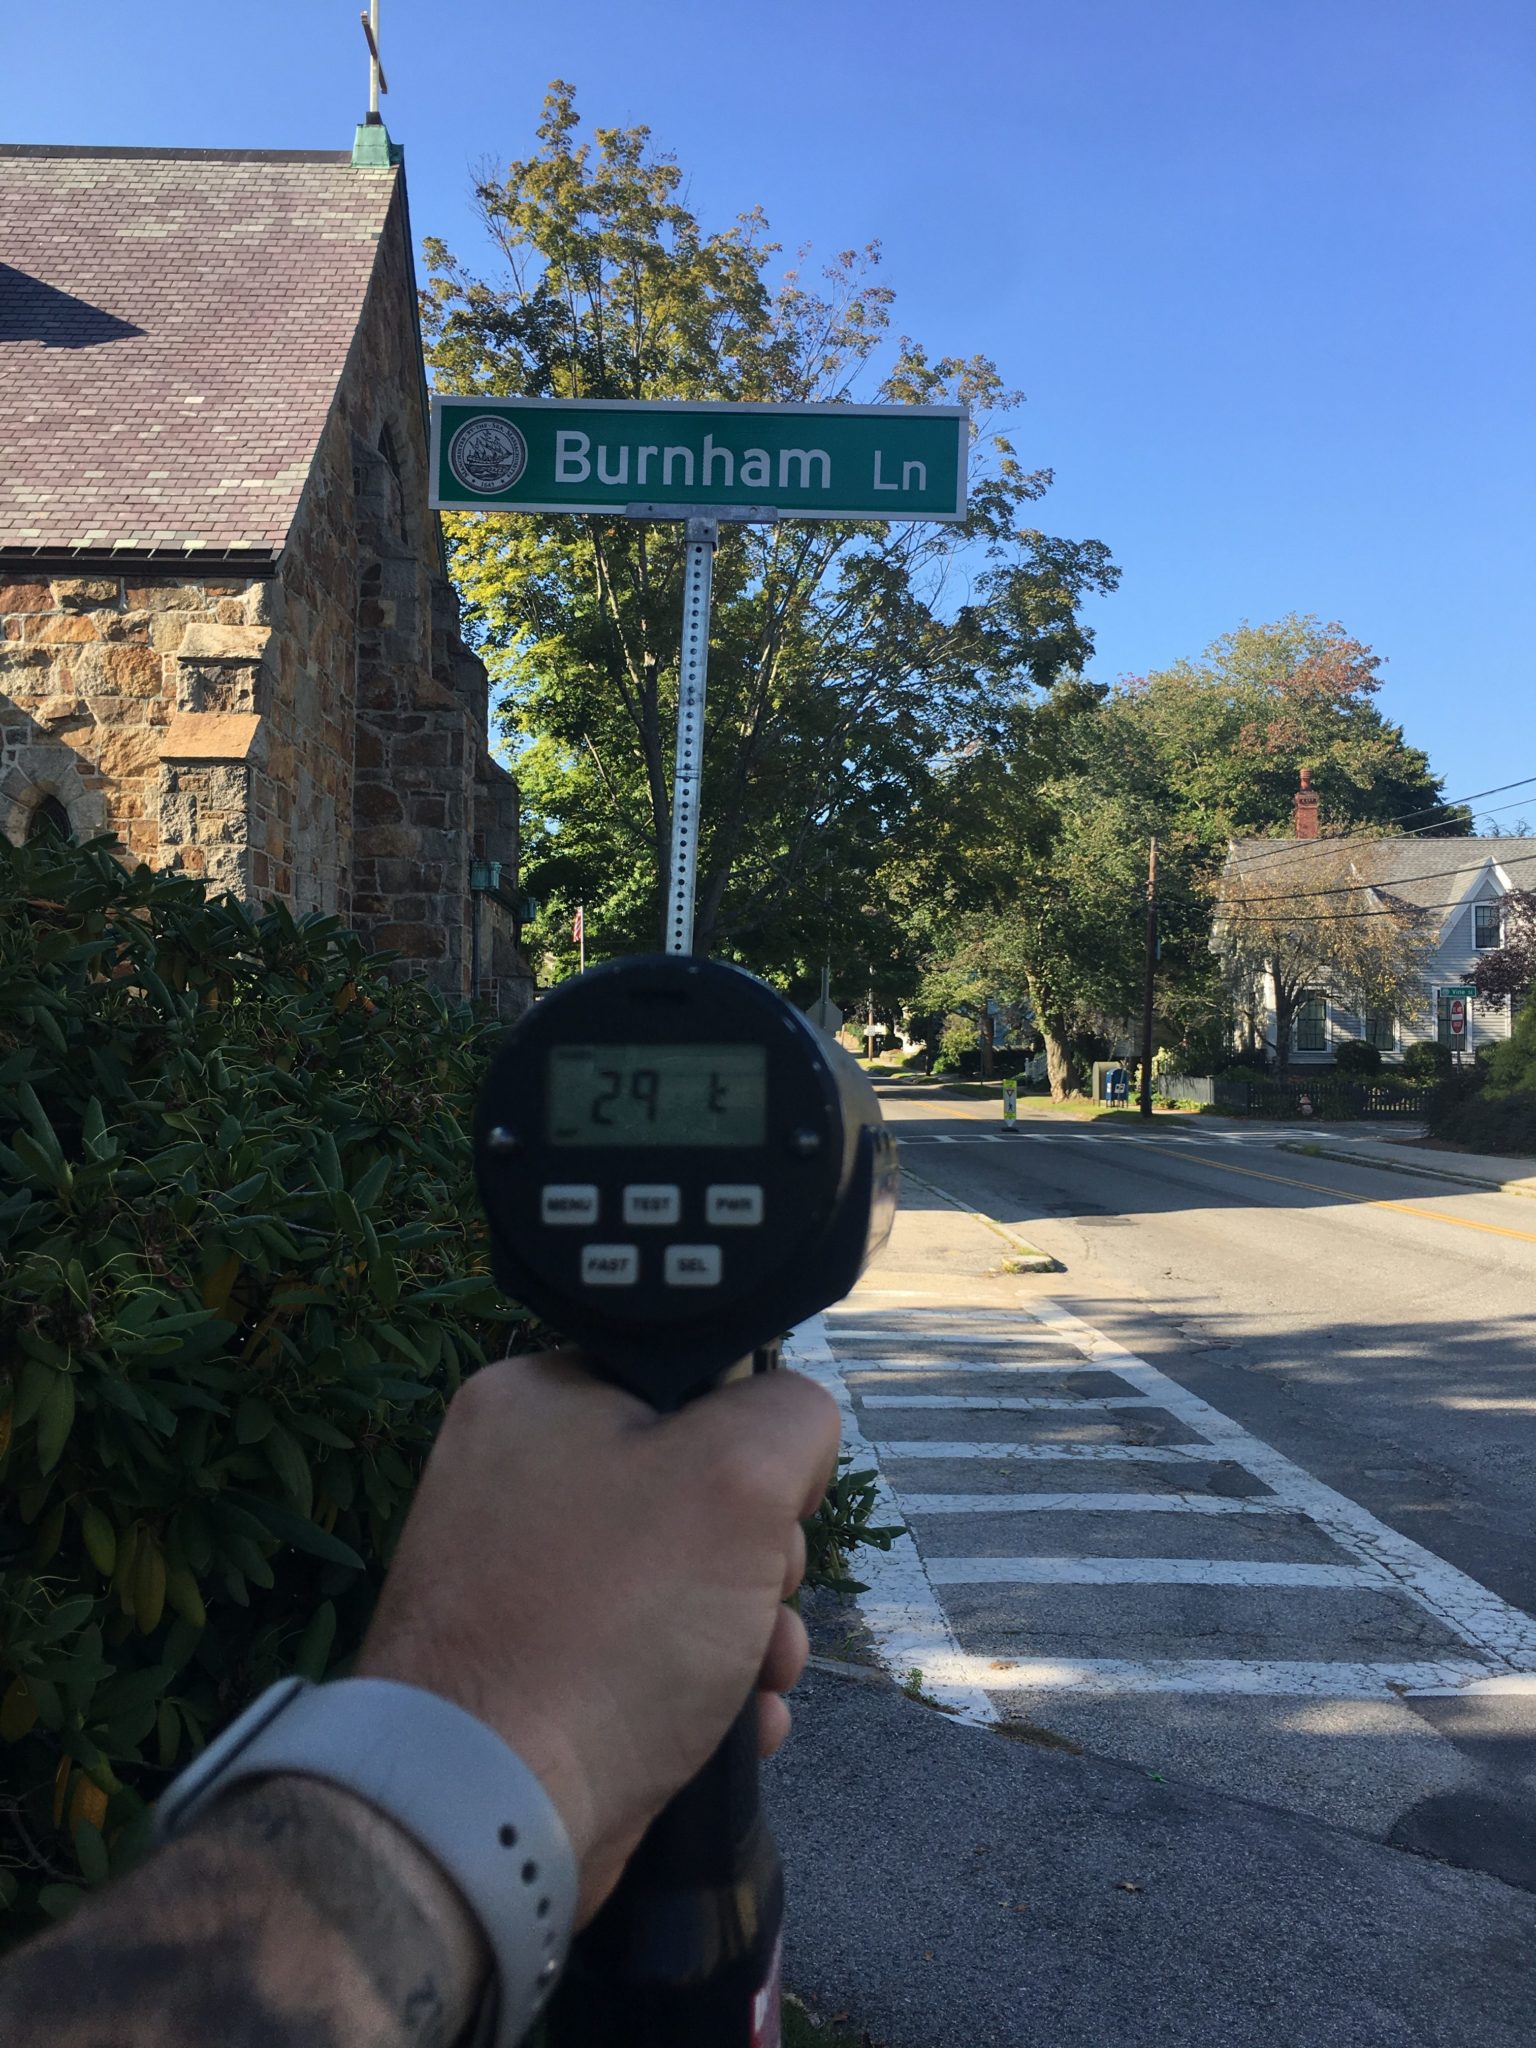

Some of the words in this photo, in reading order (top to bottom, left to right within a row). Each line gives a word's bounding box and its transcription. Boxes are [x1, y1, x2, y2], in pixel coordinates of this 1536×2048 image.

[554, 430, 831, 489] Burnham
[873, 449, 927, 491] Ln
[591, 1068, 659, 1125] 29
[632, 1197, 671, 1211] TEST
[588, 1257, 631, 1272] FAST
